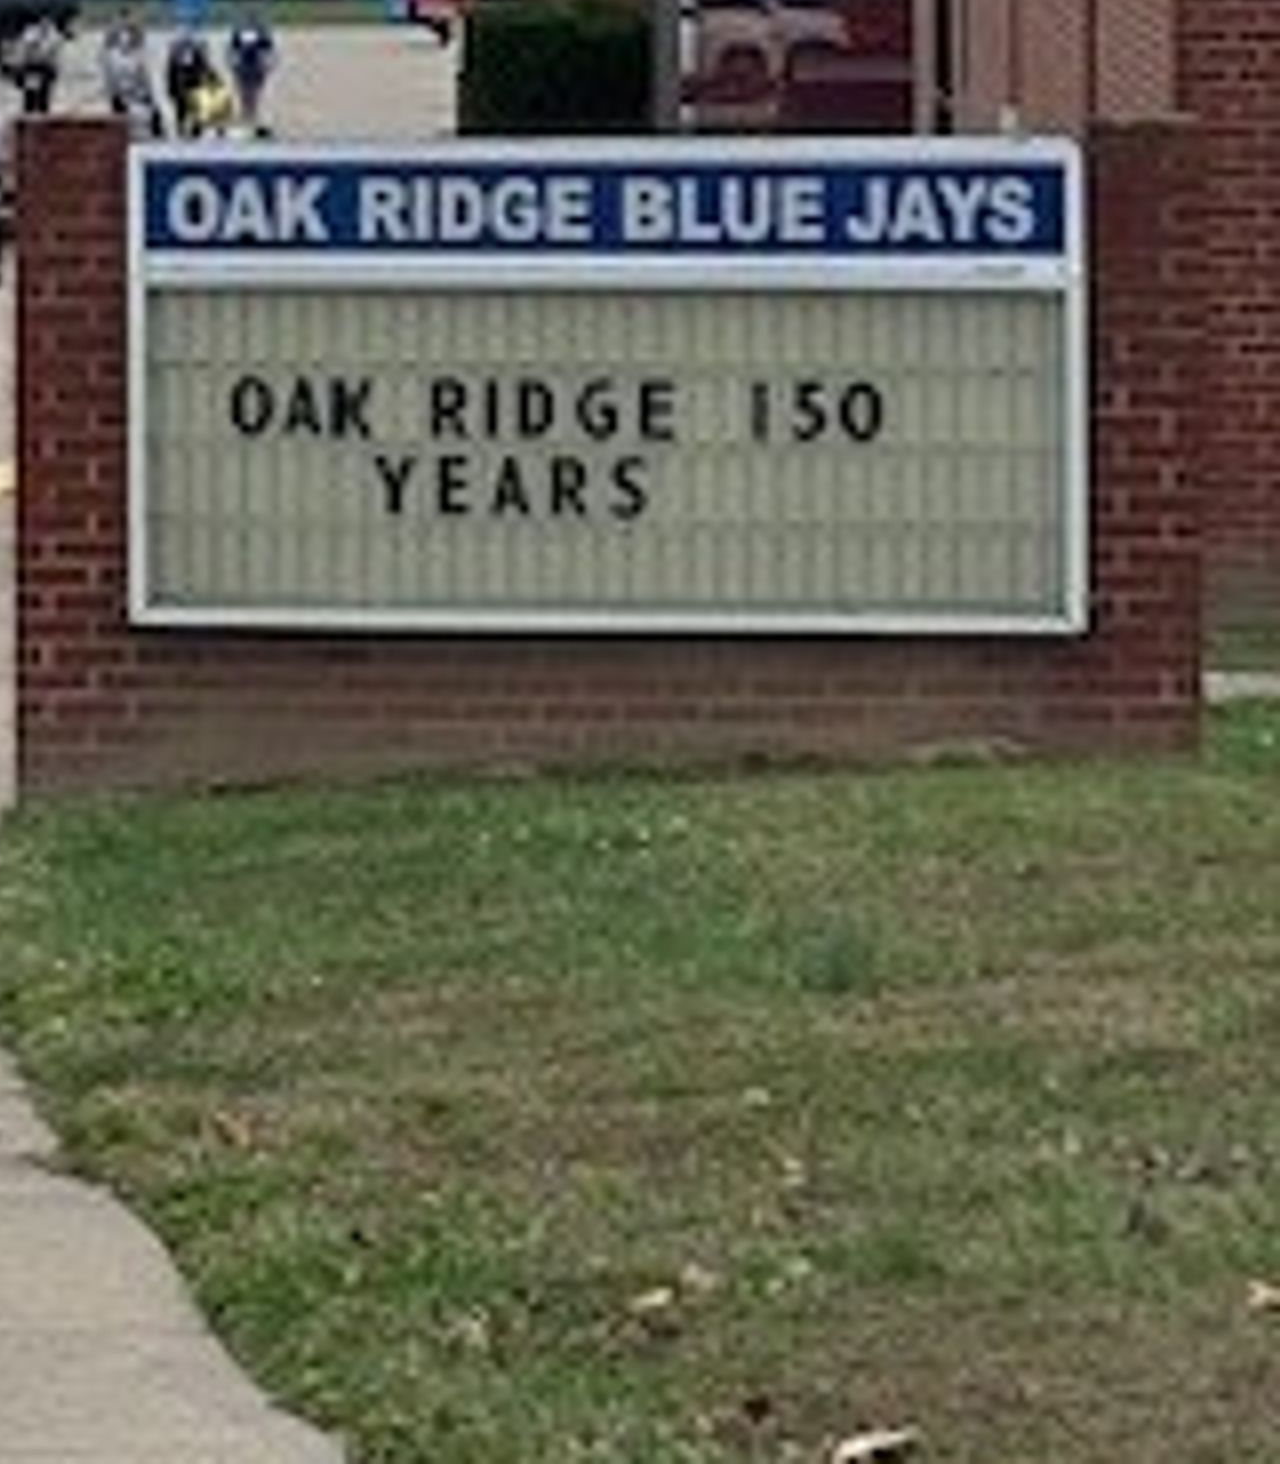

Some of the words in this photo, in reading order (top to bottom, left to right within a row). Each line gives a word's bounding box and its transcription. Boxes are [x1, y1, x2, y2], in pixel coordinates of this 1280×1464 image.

[166, 174, 330, 242] OAK
[357, 174, 594, 242] RIDGE
[621, 175, 826, 242] BLUE
[845, 175, 1035, 242] JAYS
[229, 376, 372, 436] OAK
[430, 378, 678, 438] RIDGE
[750, 381, 884, 440] 150
[375, 455, 648, 517] YEARS
